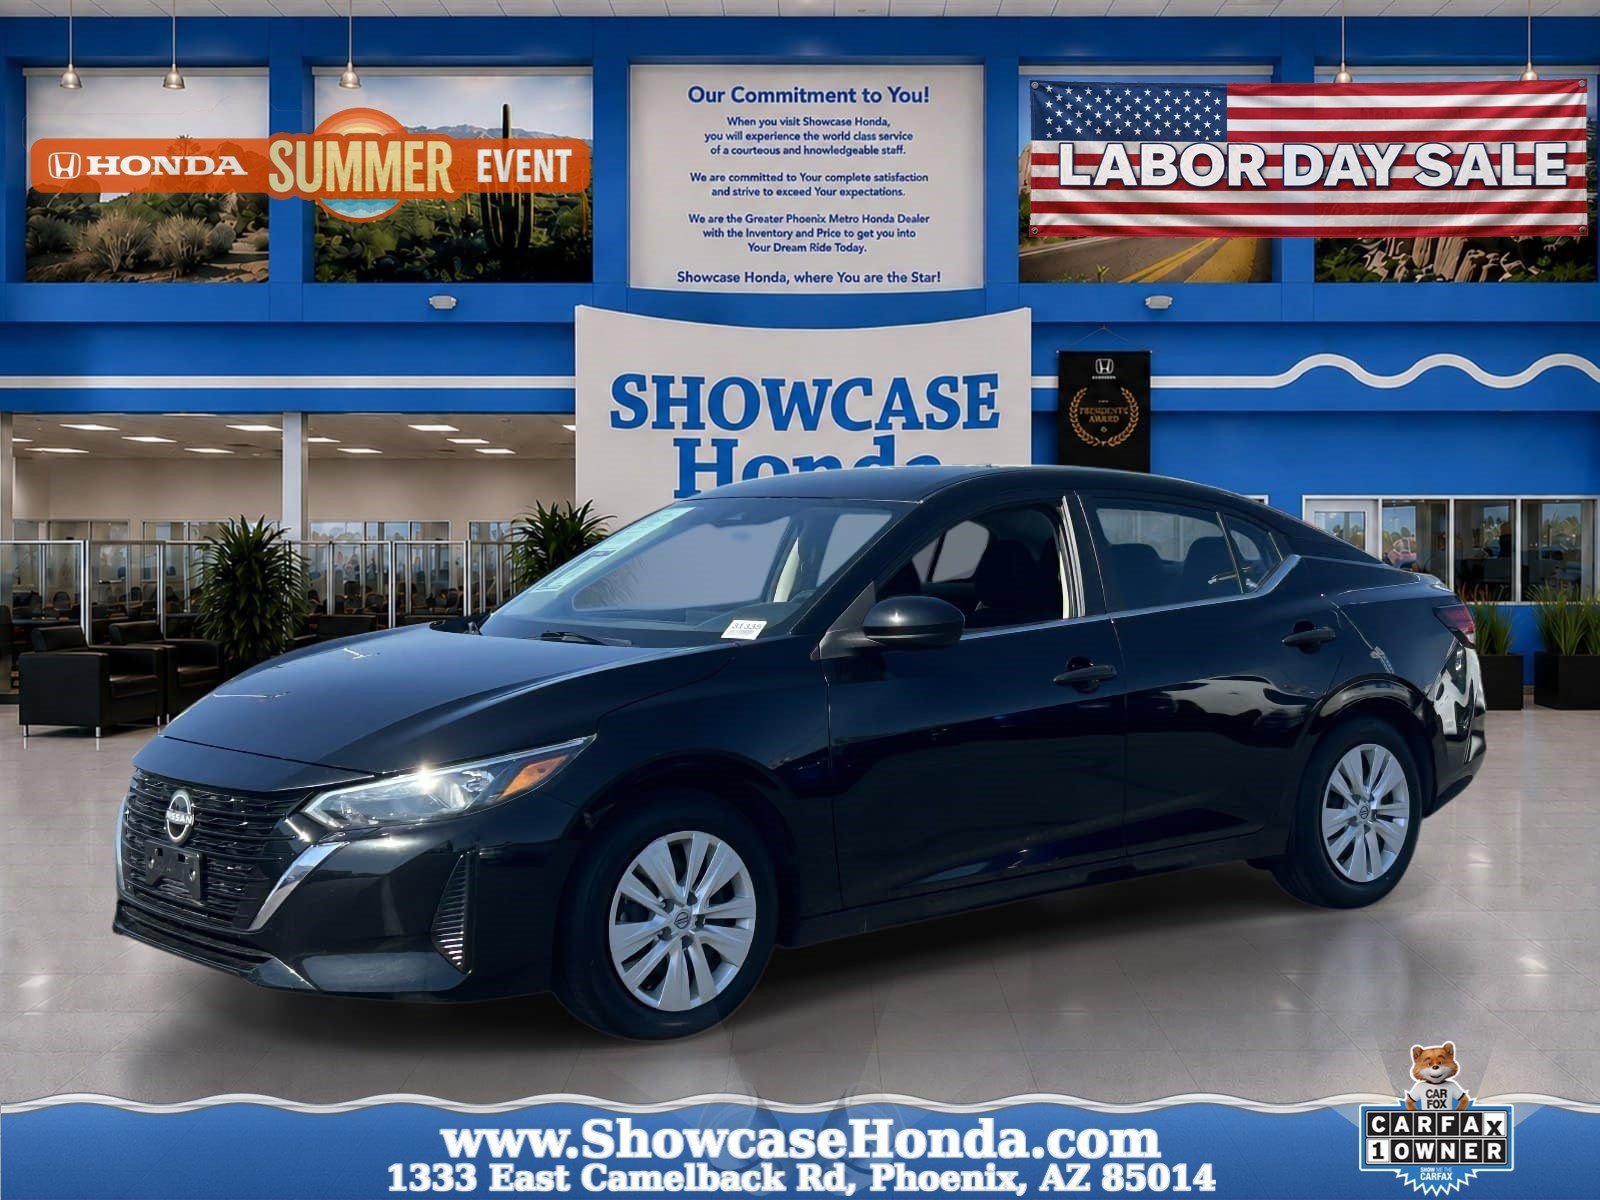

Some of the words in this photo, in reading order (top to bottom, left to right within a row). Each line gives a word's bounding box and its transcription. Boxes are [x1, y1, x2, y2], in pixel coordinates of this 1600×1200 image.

[688, 86, 725, 103] Our
[731, 86, 856, 103] Commitment
[861, 88, 882, 103] to
[887, 86, 929, 103] You!
[727, 116, 756, 126] When
[759, 119, 777, 128] you
[780, 117, 800, 126] visit
[803, 116, 852, 126] Showcase
[855, 117, 890, 127] Honda,
[705, 134, 723, 143] you
[726, 131, 742, 140] will
[745, 131, 800, 143] experience
[803, 131, 819, 140] the
[822, 131, 850, 141] world
[854, 131, 876, 140] class
[879, 131, 913, 141] service
[711, 145, 720, 154] of
[731, 147, 780, 155] courteous
[783, 145, 801, 154] and
[882, 145, 905, 154] staff.
[86, 155, 248, 176] HONDA
[268, 139, 455, 193] SUMMER
[477, 148, 573, 183] EVENT
[1058, 142, 1268, 188] LABOR
[1281, 142, 1405, 188] DAY
[1414, 142, 1568, 188] SALE
[690, 173, 707, 182] We
[729, 172, 783, 182] committed
[800, 173, 822, 182] Your
[825, 173, 871, 184] complete
[874, 172, 928, 182] satisfaction
[712, 186, 730, 196] and
[733, 187, 760, 196] strive
[763, 188, 773, 196] to
[776, 187, 811, 196] exceed
[815, 187, 837, 196] Your
[840, 187, 905, 199] expectations.
[689, 214, 705, 223] We
[726, 214, 742, 223] the
[745, 214, 784, 223] Greater
[786, 214, 826, 223] Phoenix
[829, 214, 859, 223] Metro
[862, 214, 894, 223] Honda
[898, 214, 930, 223] Dealer
[703, 228, 724, 237] with
[727, 228, 743, 237] the
[746, 228, 793, 240] Inventory
[796, 228, 814, 238] and
[817, 228, 841, 238] Price
[857, 230, 874, 240] get
[876, 231, 894, 240] you
[897, 228, 916, 237] into
[748, 243, 771, 252] Your
[774, 243, 807, 252] Dream
[810, 243, 832, 252] Ride
[834, 243, 866, 254] Today.
[677, 271, 740, 283] Showcase
[745, 271, 789, 285] Honda,
[794, 271, 833, 283] where
[837, 272, 860, 283] You
[864, 275, 883, 283] are
[887, 271, 907, 283] the
[912, 272, 940, 283] Star!
[610, 373, 1001, 431] SHOWCASE
